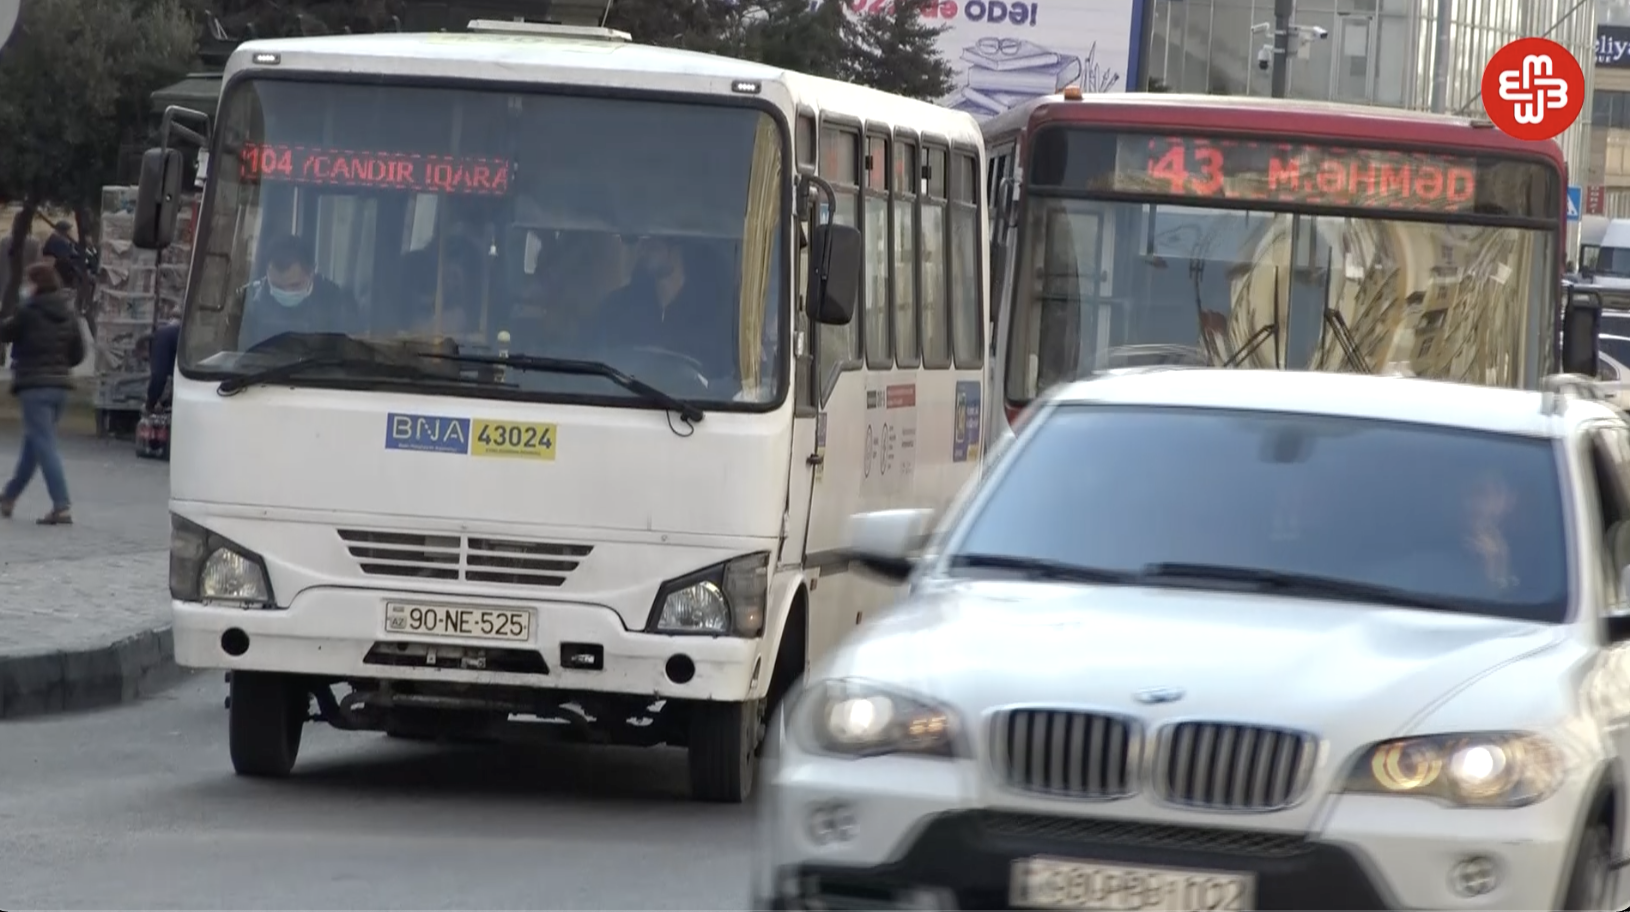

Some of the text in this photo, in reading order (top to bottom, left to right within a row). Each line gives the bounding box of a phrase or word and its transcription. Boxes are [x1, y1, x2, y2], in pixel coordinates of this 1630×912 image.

[1152, 147, 1224, 196] 43
[392, 415, 464, 443] BNA
[477, 424, 552, 449] 43024
[409, 607, 523, 637] 90-NE-525
